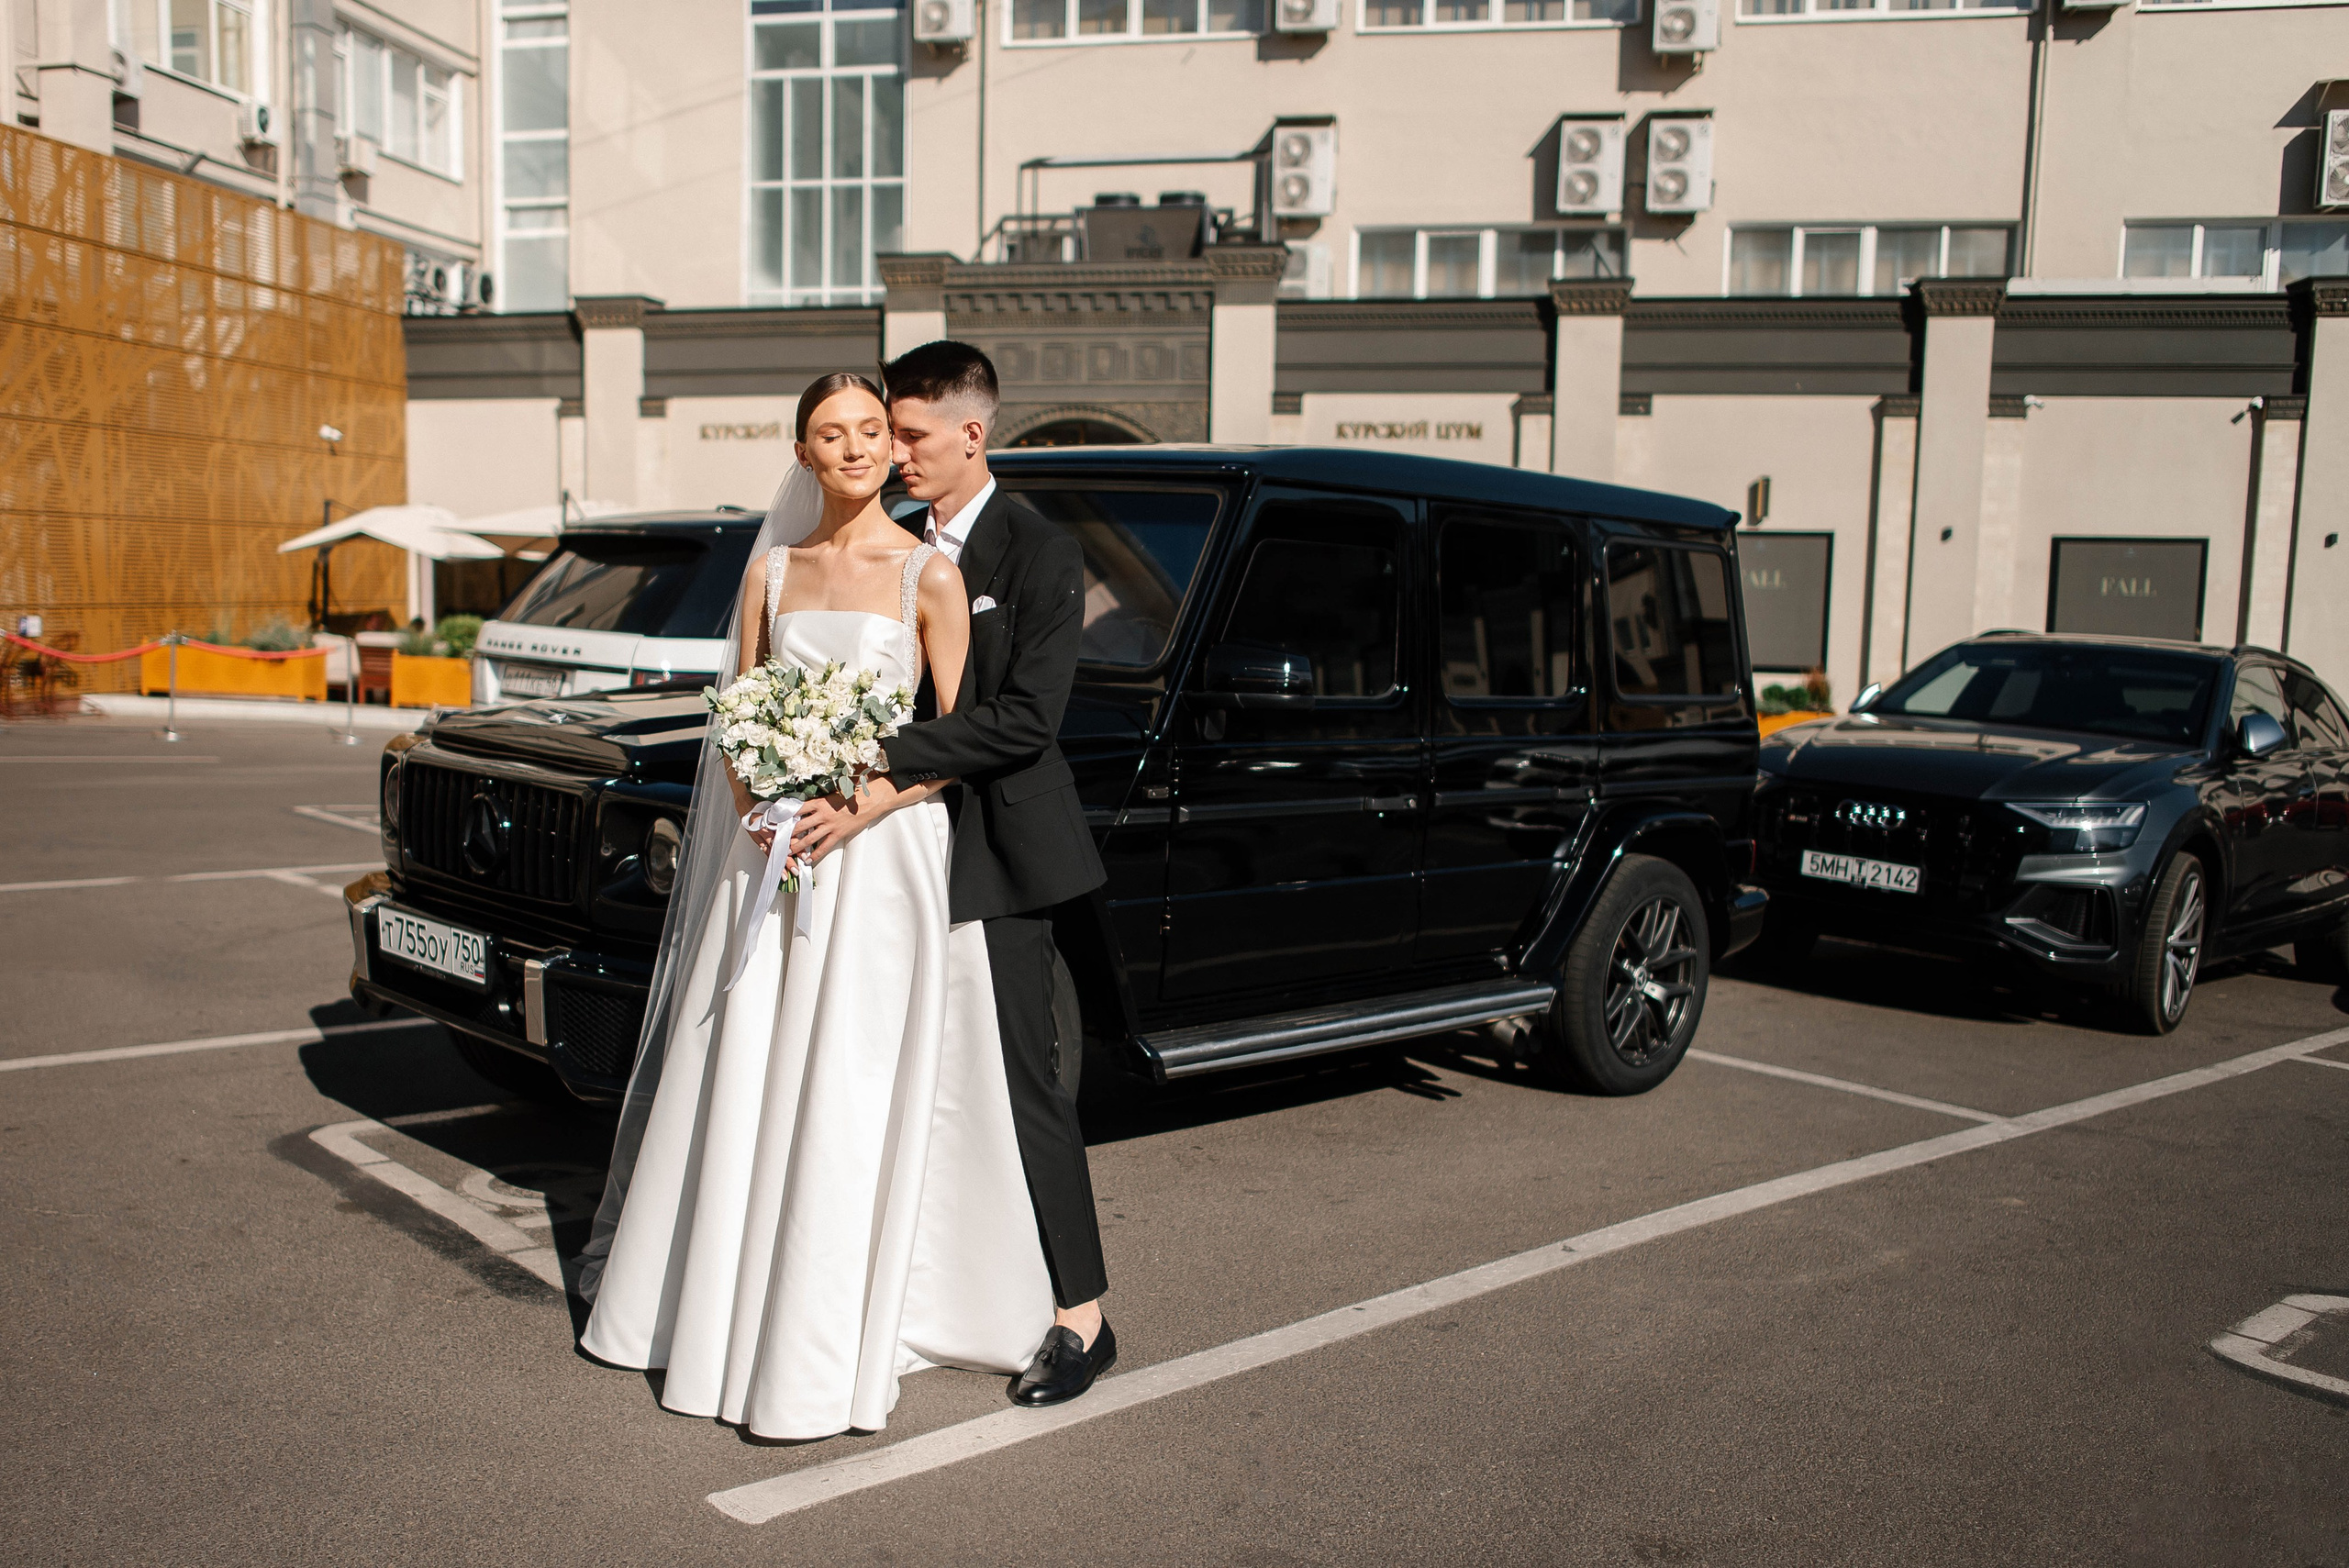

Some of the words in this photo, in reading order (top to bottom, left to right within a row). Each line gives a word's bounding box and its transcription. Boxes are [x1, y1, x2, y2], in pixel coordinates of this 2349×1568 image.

[700, 421, 781, 440] КУРСКИЙ
[1336, 419, 1429, 439] КУРСКИЙ
[1436, 421, 1483, 440] ЦУМ
[1742, 569, 1786, 588] ALL
[486, 639, 523, 651] RANGE
[530, 642, 582, 656] ROVER
[460, 962, 474, 975] RUS
